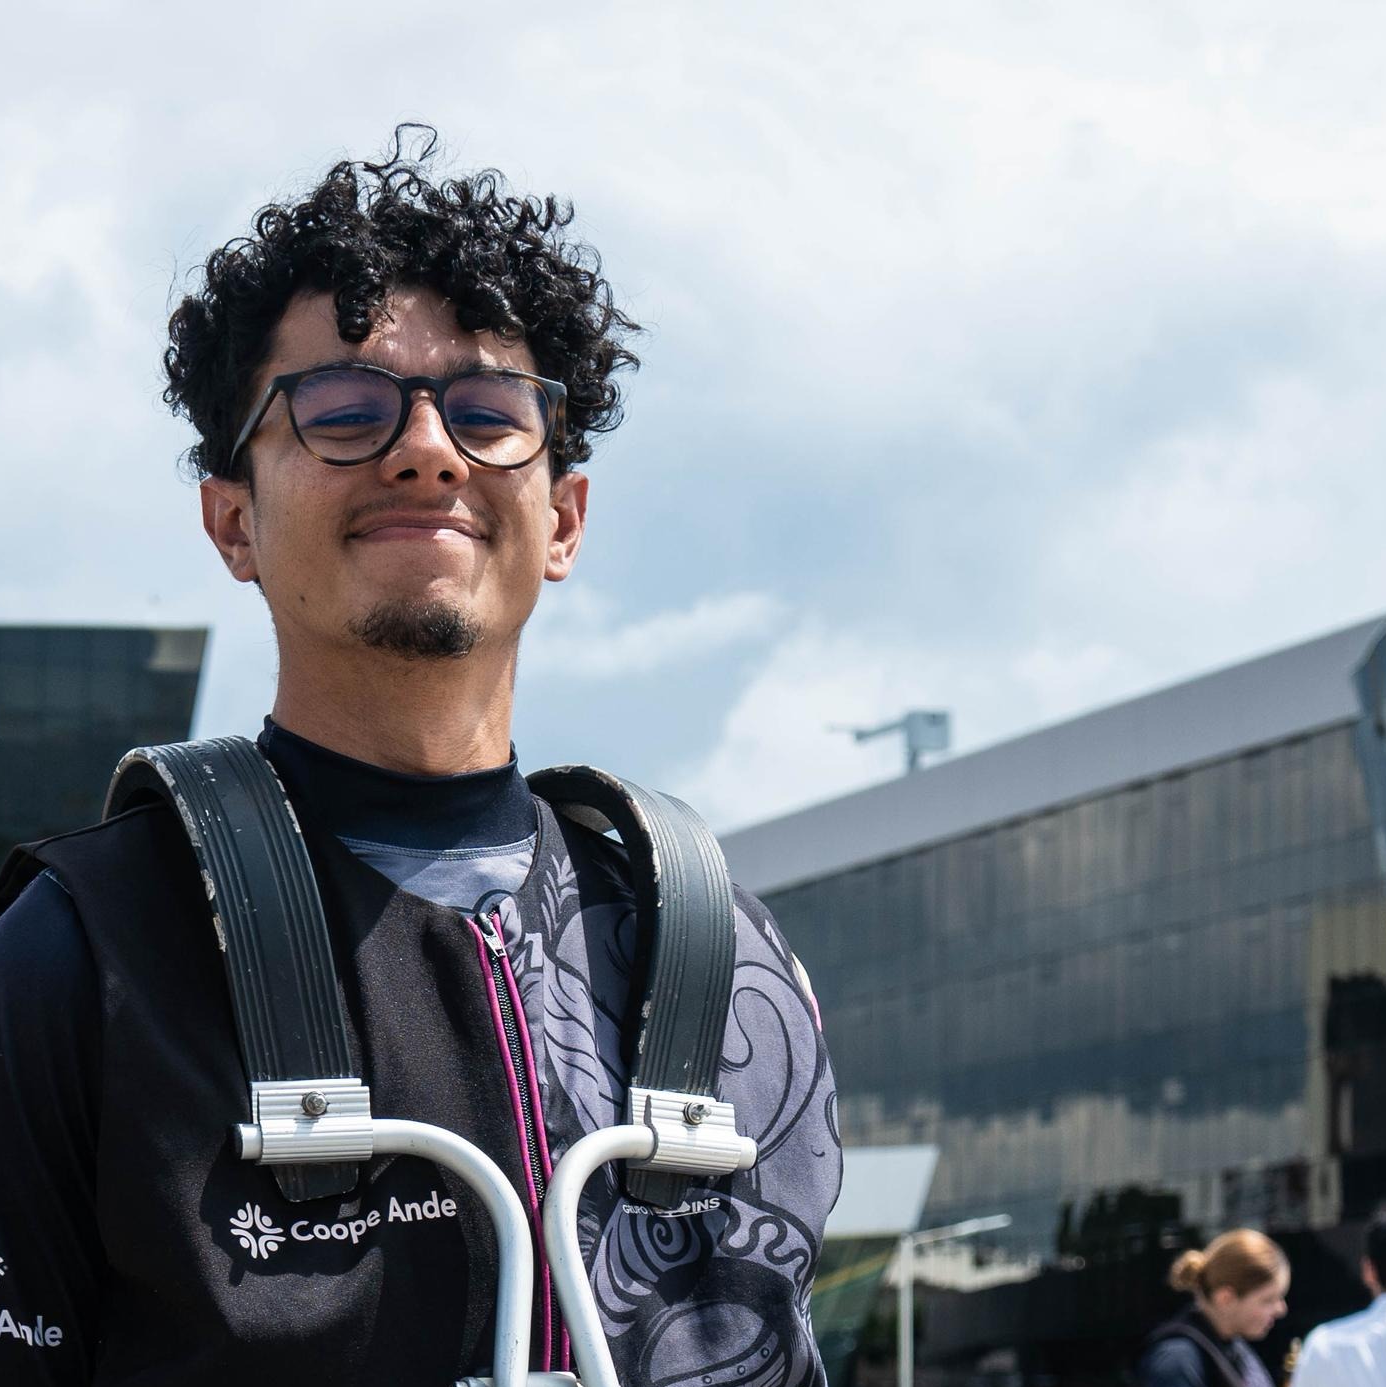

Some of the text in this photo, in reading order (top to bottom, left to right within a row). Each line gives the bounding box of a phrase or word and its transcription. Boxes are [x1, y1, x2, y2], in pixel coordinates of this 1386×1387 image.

[290, 1190, 457, 1244] Coope Ande
[691, 1197, 721, 1212] INS
